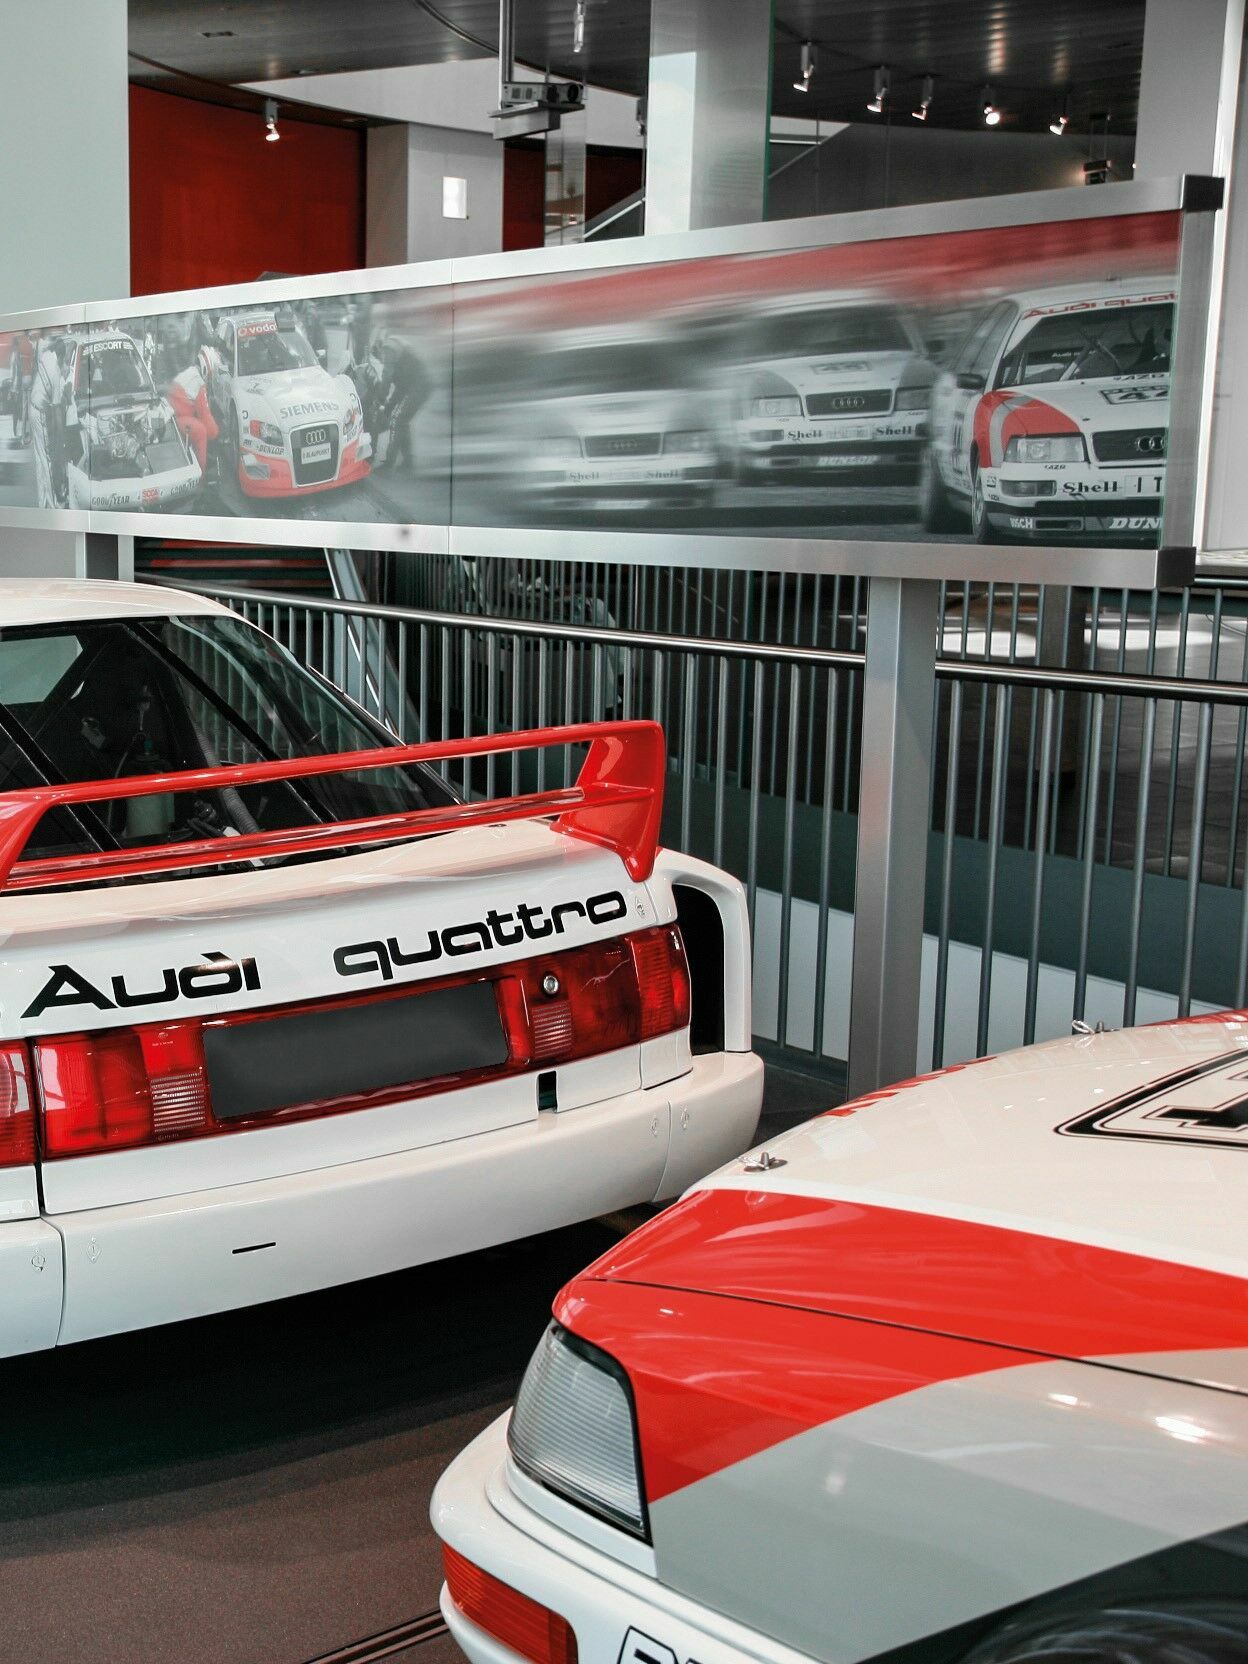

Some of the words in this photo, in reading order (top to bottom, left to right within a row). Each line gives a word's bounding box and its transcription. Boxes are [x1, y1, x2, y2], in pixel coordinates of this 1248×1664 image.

[1023, 302, 1097, 320] Audi
[94, 341, 122, 352] ESCORT
[279, 401, 340, 419] SIEMENS
[787, 429, 823, 439] Shell
[876, 425, 913, 435] Shell
[1062, 481, 1118, 494] Shell
[333, 889, 628, 981] quattro
[20, 951, 262, 1019] Audi
